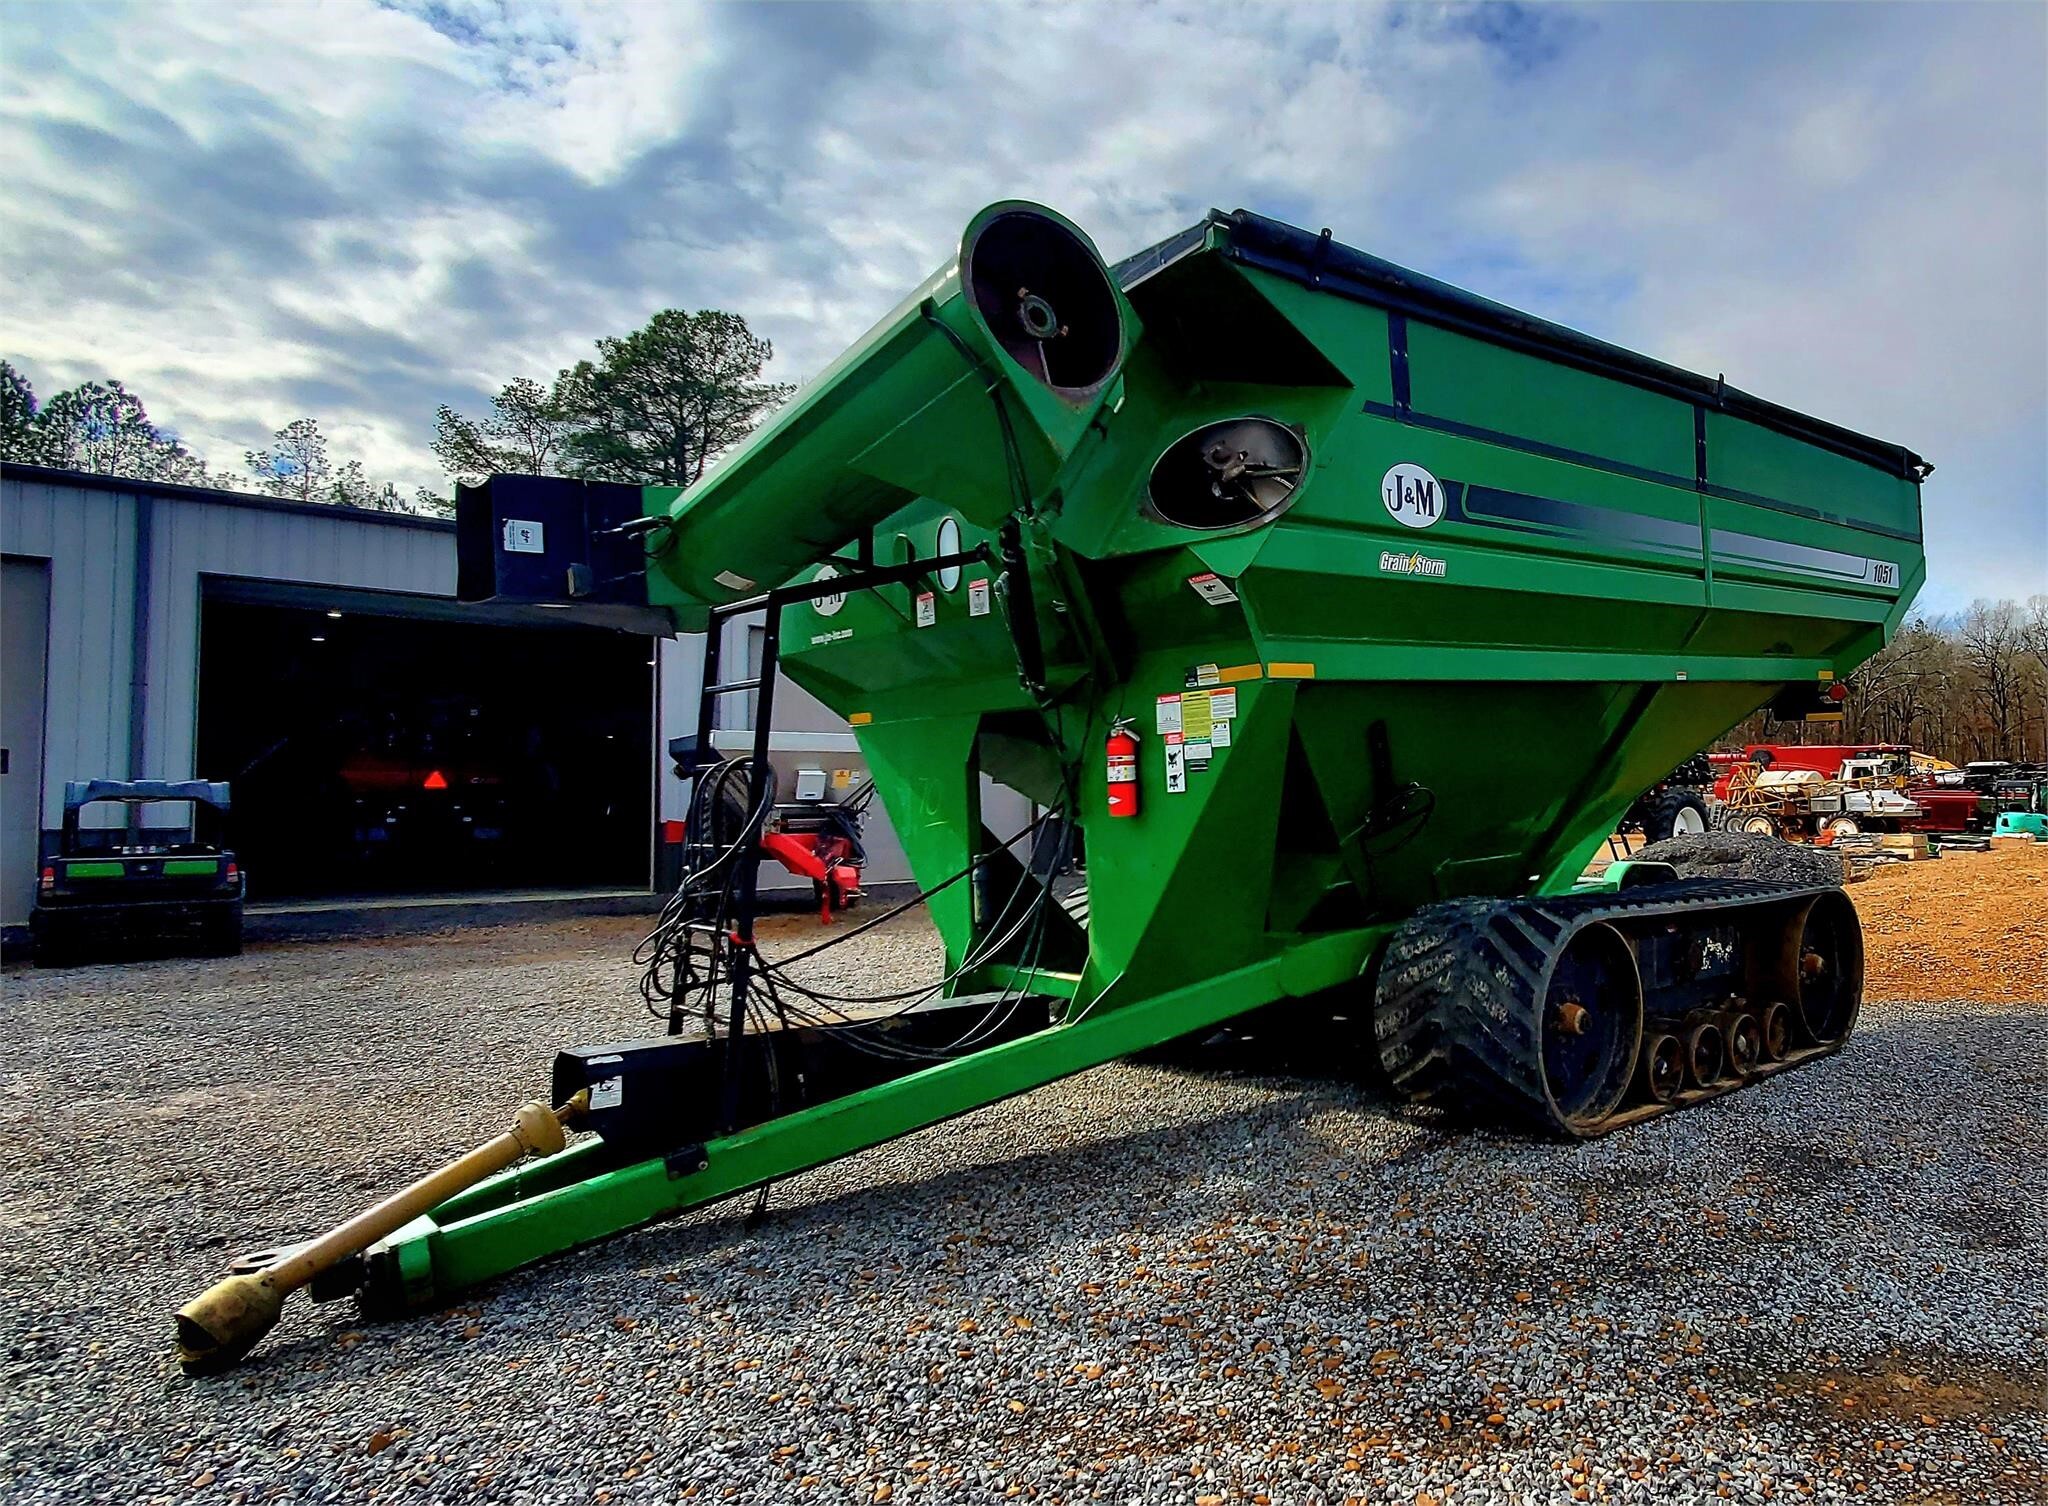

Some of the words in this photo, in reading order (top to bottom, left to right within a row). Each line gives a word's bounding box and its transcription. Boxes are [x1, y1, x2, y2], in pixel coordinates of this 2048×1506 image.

[1386, 474, 1435, 517] J&M
[1380, 552, 1410, 572] Grain
[1415, 556, 1446, 575] Storm
[1873, 564, 1893, 584] 1051
